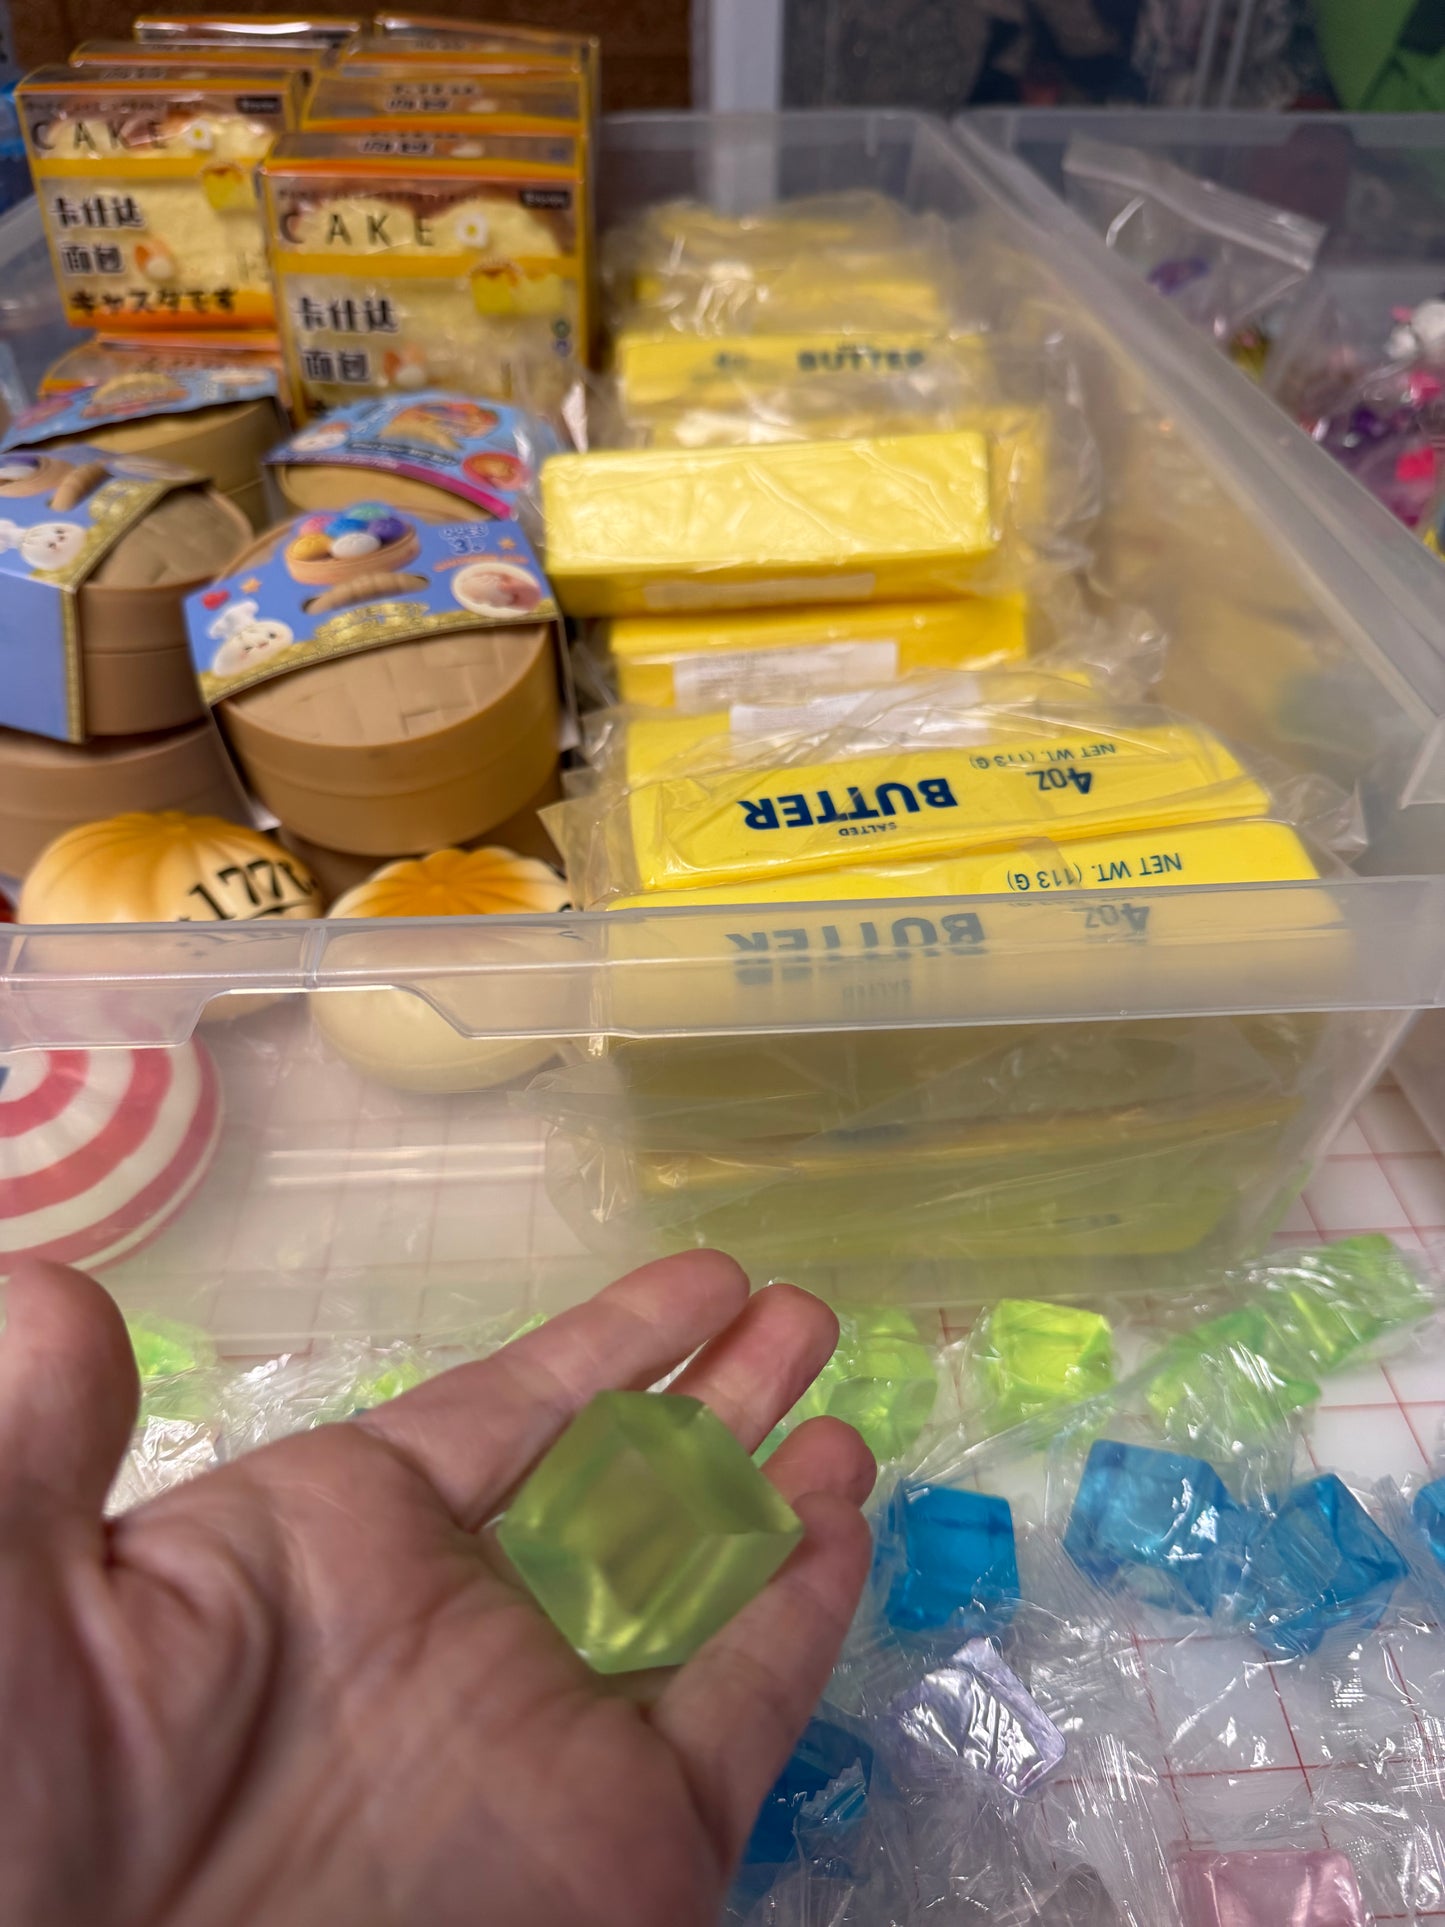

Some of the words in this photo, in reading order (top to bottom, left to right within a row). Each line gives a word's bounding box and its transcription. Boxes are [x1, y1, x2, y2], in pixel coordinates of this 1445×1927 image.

[31, 120, 169, 150] CAKE
[279, 210, 435, 247] CAKE
[1081, 743, 1116, 759] NET
[736, 778, 959, 831] BUTTER
[838, 821, 898, 837] SALTED
[1037, 863, 1082, 889] (113
[1091, 860, 1132, 883] WT.
[1139, 852, 1183, 876] NET
[1006, 870, 1031, 892] G)
[725, 912, 988, 983] BUTTER
